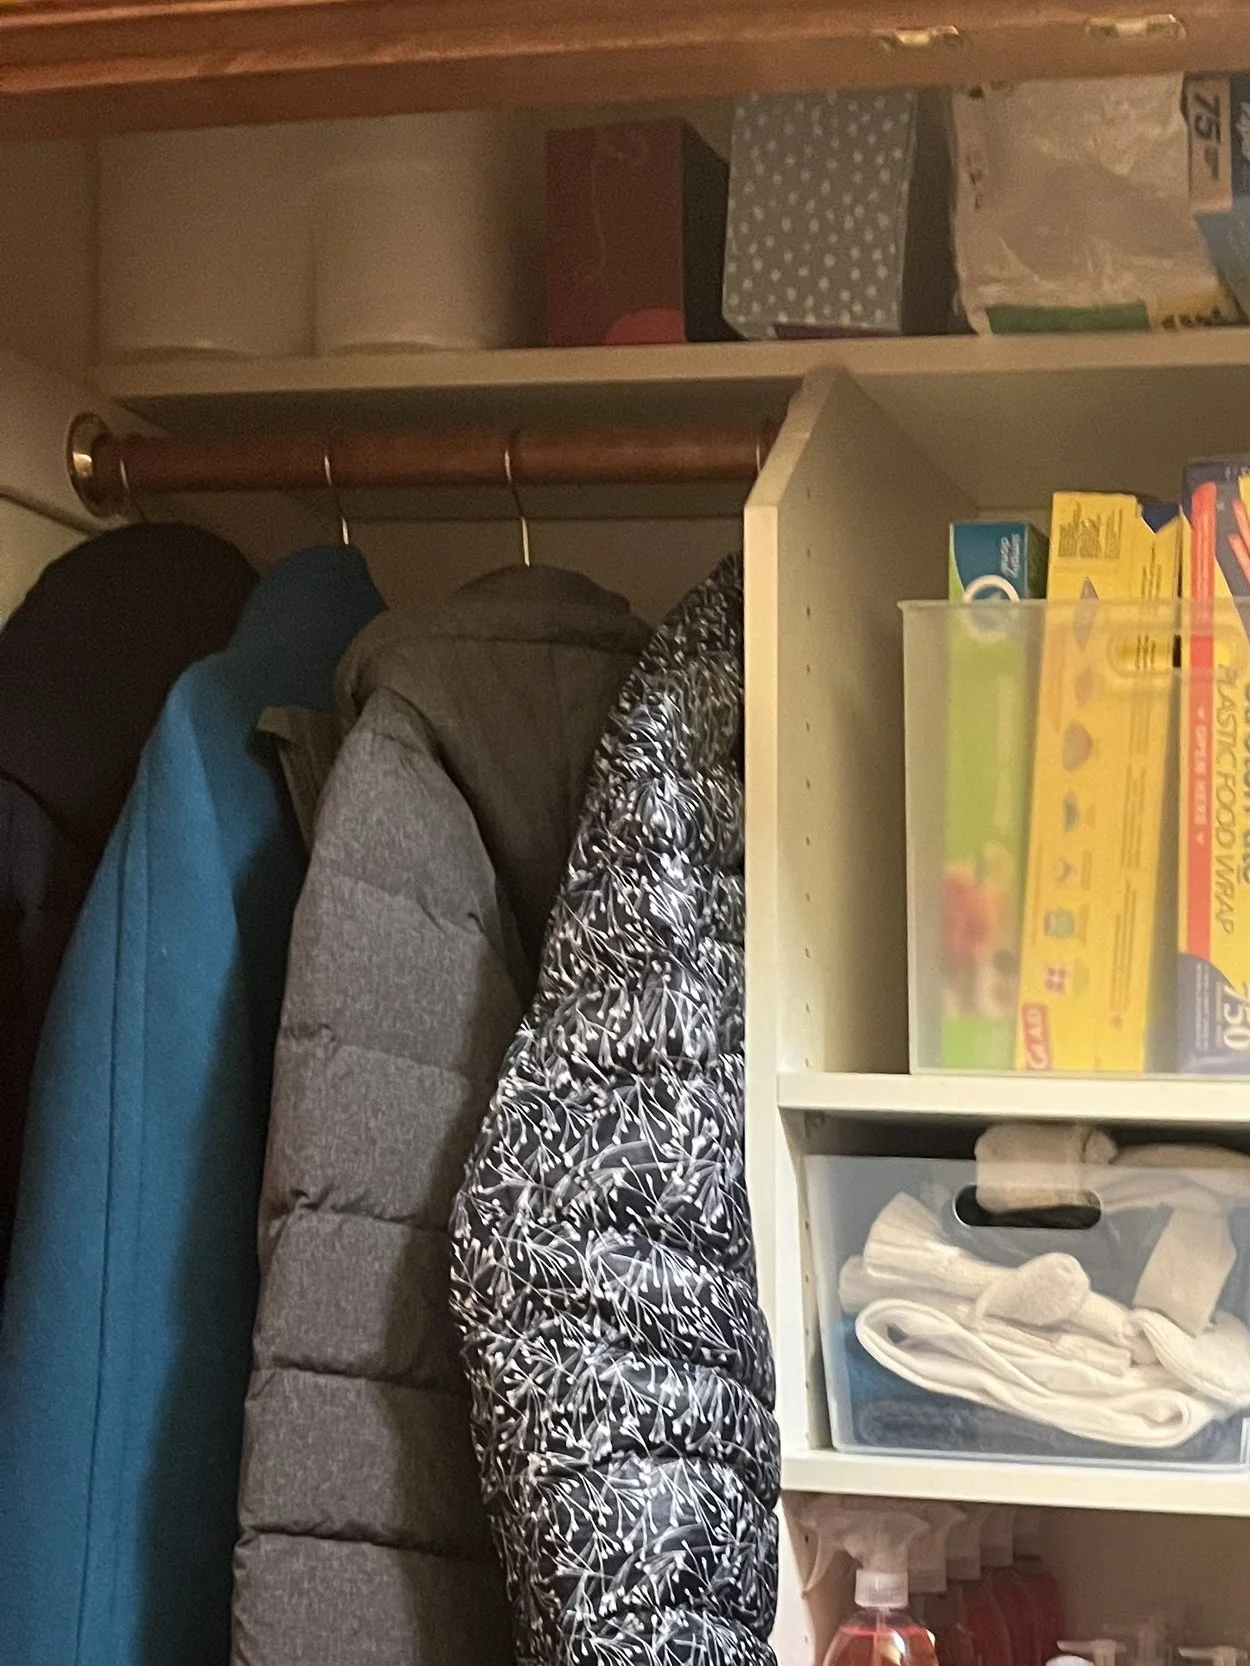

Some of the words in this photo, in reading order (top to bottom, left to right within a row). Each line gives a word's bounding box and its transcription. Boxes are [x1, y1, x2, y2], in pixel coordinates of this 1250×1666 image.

[1194, 92, 1221, 144] 75
[1216, 664, 1238, 768] PLASTIC
[1215, 771, 1236, 853] FOOD
[1214, 855, 1236, 935] WRAP
